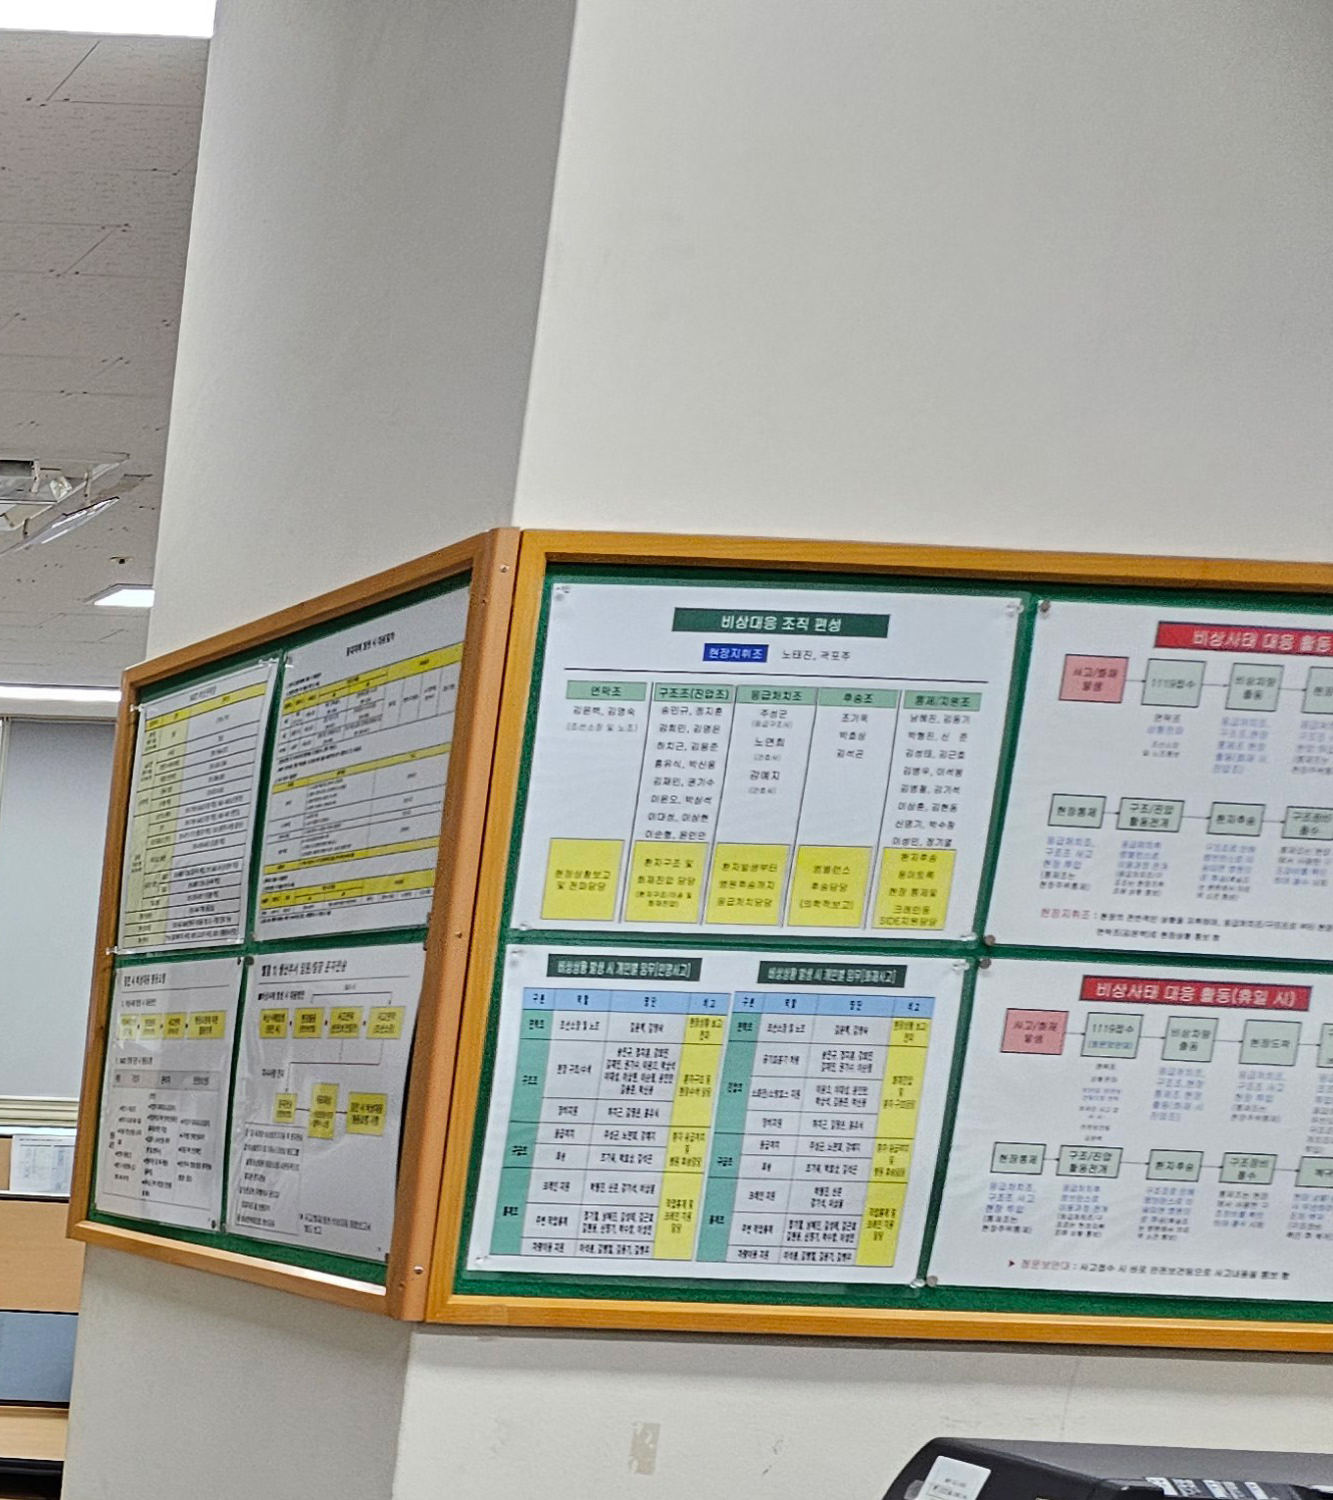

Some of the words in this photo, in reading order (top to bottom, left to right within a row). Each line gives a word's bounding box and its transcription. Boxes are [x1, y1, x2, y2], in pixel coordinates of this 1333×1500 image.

[721, 615, 778, 631] 비상대응
[782, 618, 809, 631] 조직
[815, 618, 842, 632] 편성
[1193, 631, 1257, 647] 비상사태
[1263, 633, 1296, 650] 대응
[1097, 983, 1158, 999] 비상사태
[1165, 987, 1194, 1001] 대응
